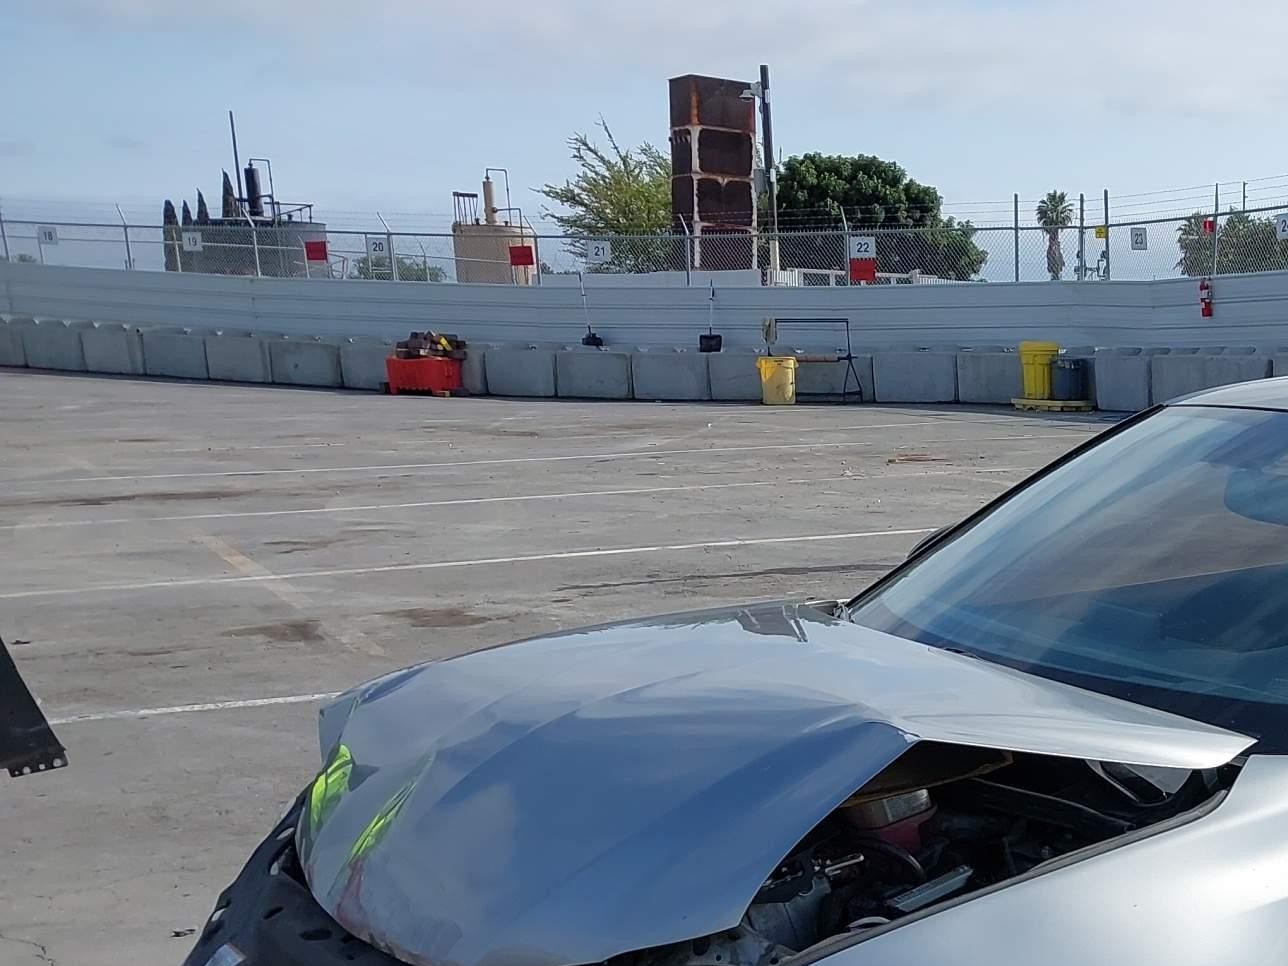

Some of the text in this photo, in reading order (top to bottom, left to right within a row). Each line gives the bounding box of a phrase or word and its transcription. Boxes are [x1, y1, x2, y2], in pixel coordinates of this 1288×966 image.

[188, 236, 197, 247] 19
[1134, 232, 1144, 245] 23
[372, 242, 384, 252] 20
[594, 246, 605, 256] 21
[856, 241, 870, 253] 22
